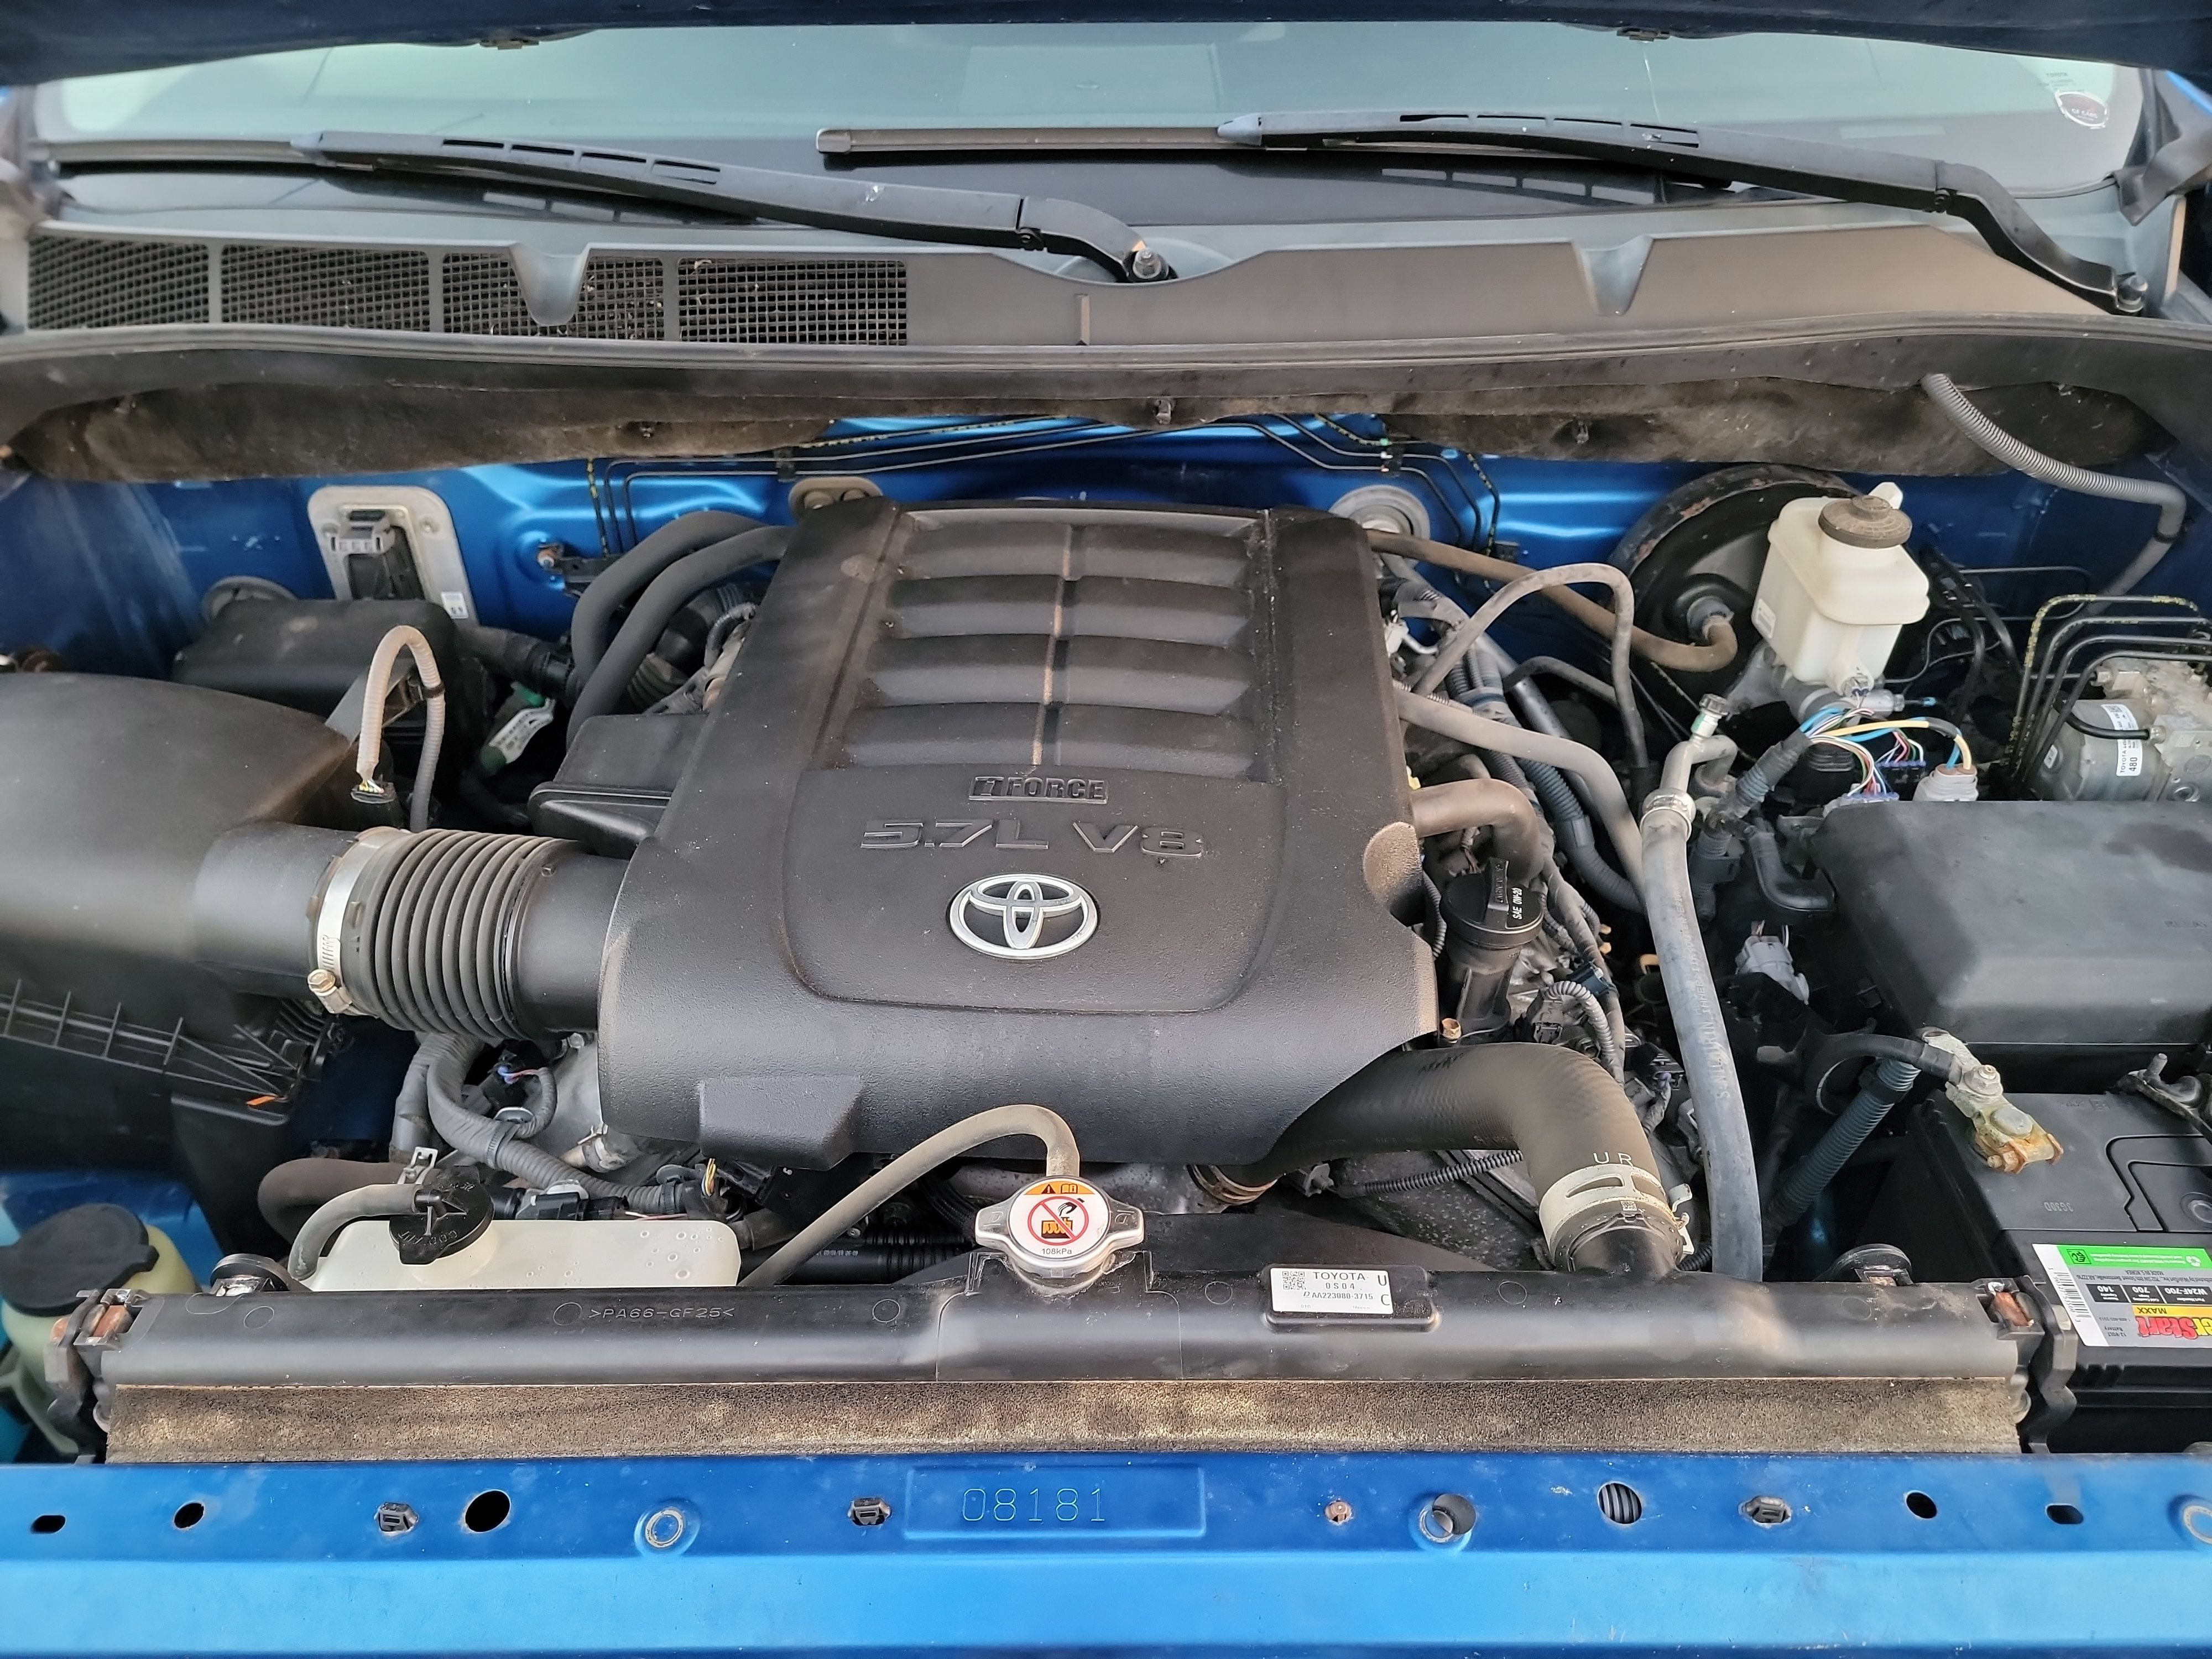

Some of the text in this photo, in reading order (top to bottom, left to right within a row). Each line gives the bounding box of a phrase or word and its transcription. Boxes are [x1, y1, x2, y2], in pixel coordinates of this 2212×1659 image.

[2128, 757, 2138, 772] 480
[860, 819, 1203, 857] 5.7L V8
[1511, 887, 1522, 920] SAE 0W-20
[1312, 1271, 1366, 1281] TOYOTA
[1378, 1275, 1387, 1286] U
[2165, 1287, 2208, 1296] W24F-700
[1380, 1294, 1390, 1306] C
[2135, 1316, 2212, 1340] erStart
[963, 1488, 1105, 1522] 08181
